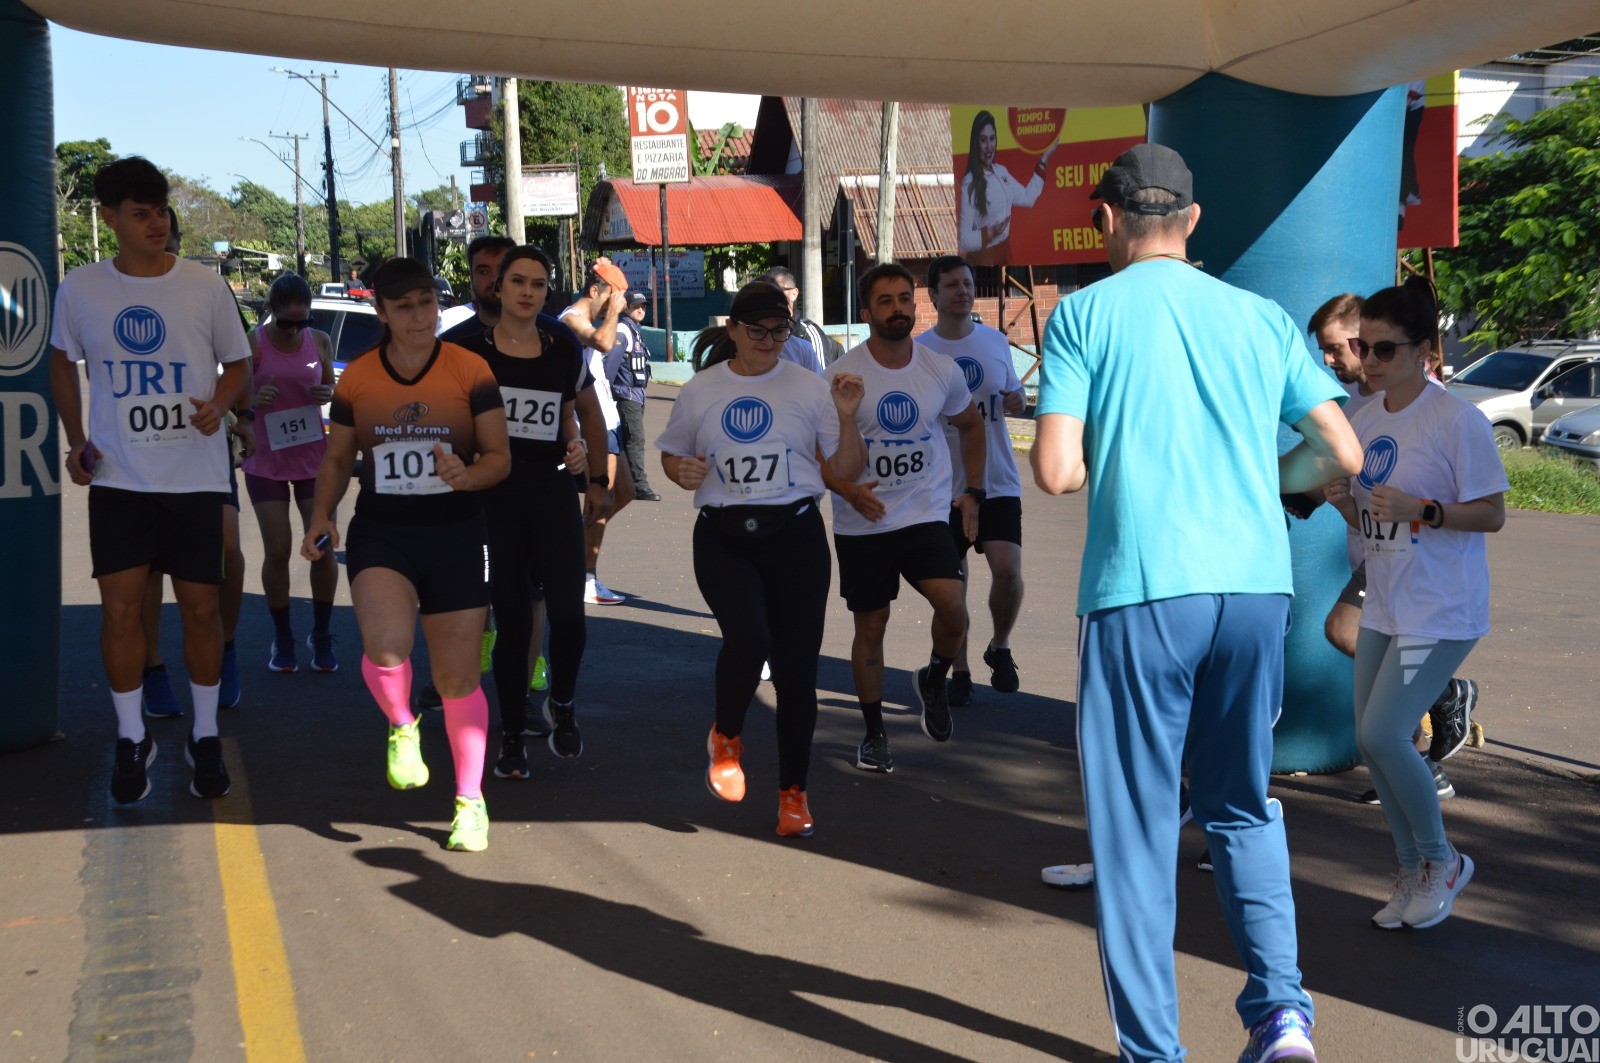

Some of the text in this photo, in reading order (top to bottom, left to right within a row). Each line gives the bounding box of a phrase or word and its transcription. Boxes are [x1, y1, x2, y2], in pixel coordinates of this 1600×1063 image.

[636, 93, 677, 102] NOTA
[635, 101, 679, 133] 10
[1017, 110, 1050, 123] TEMPO E
[1017, 122, 1056, 136] DINHEIRO!
[634, 139, 684, 150] RESTAURANTE
[637, 152, 685, 164] E PIZZARIA
[636, 163, 687, 181] DO MAGRÃO
[1055, 162, 1113, 188] SEU NO
[1053, 227, 1104, 251] FREDE
[102, 360, 187, 398] URI
[129, 403, 187, 432] 001
[506, 397, 556, 426] 126
[280, 418, 307, 435] 151
[374, 425, 450, 435] Med Forma
[383, 450, 438, 480] 101
[724, 453, 780, 484] 127
[875, 450, 924, 478] 068
